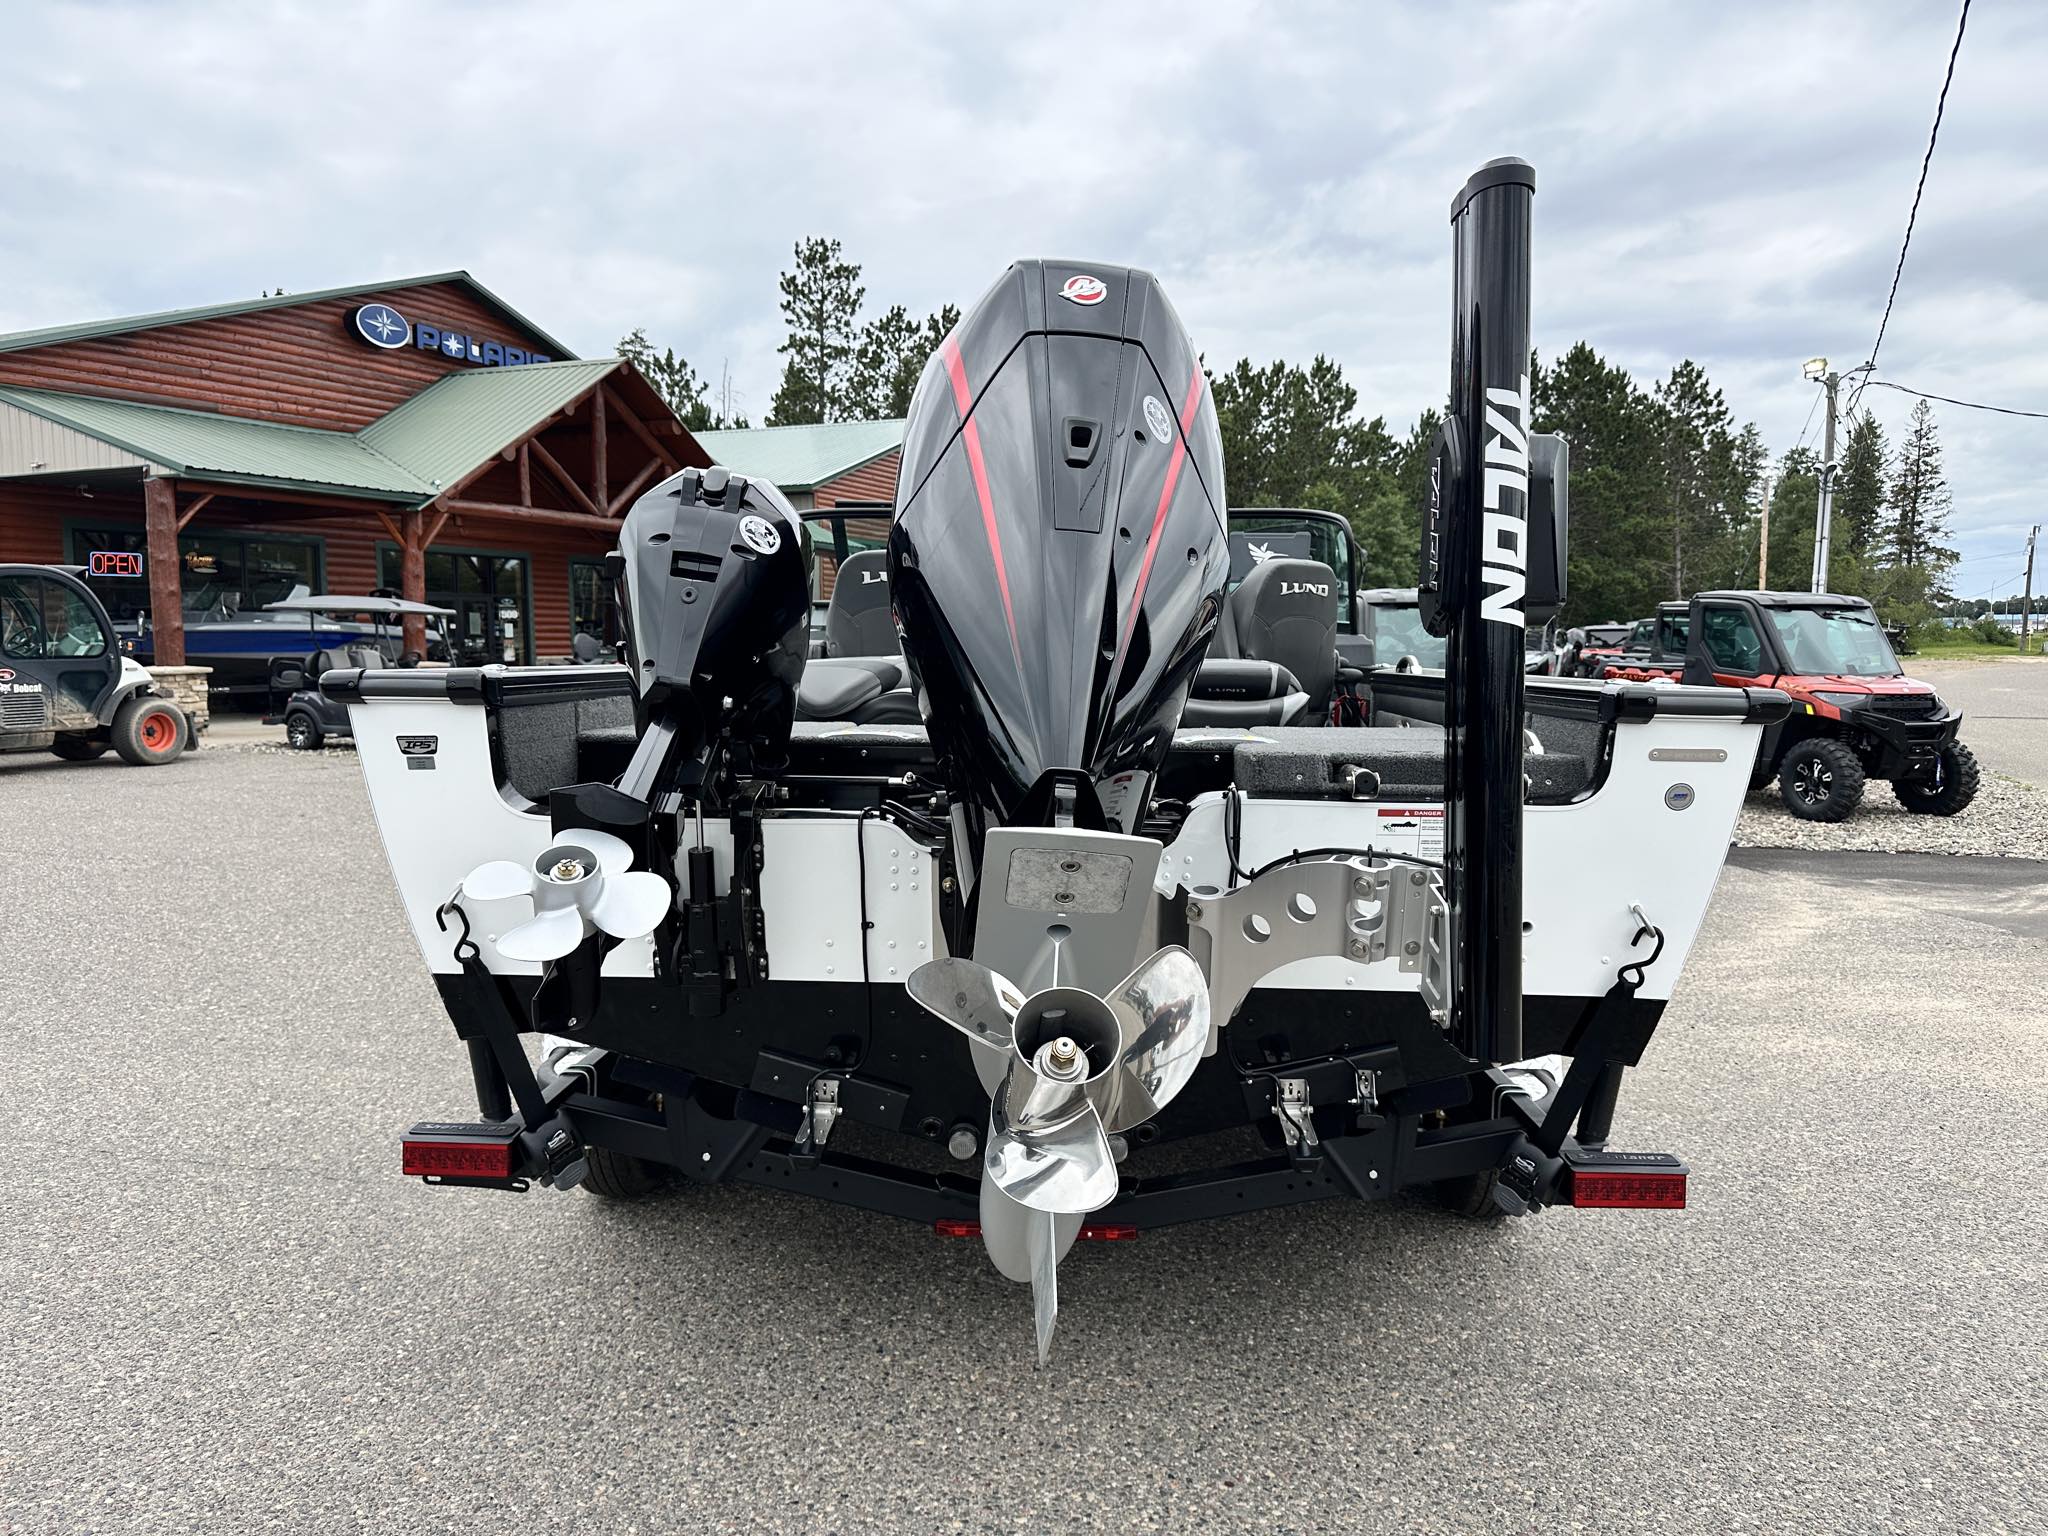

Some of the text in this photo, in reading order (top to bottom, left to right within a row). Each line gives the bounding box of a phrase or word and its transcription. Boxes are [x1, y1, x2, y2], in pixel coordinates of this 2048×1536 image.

[1480, 374, 1530, 629] TALON
[1428, 457, 1441, 592] TALON
[92, 554, 142, 574] OPEN
[1280, 581, 1329, 597] LUND
[13, 683, 43, 693] Bobcat
